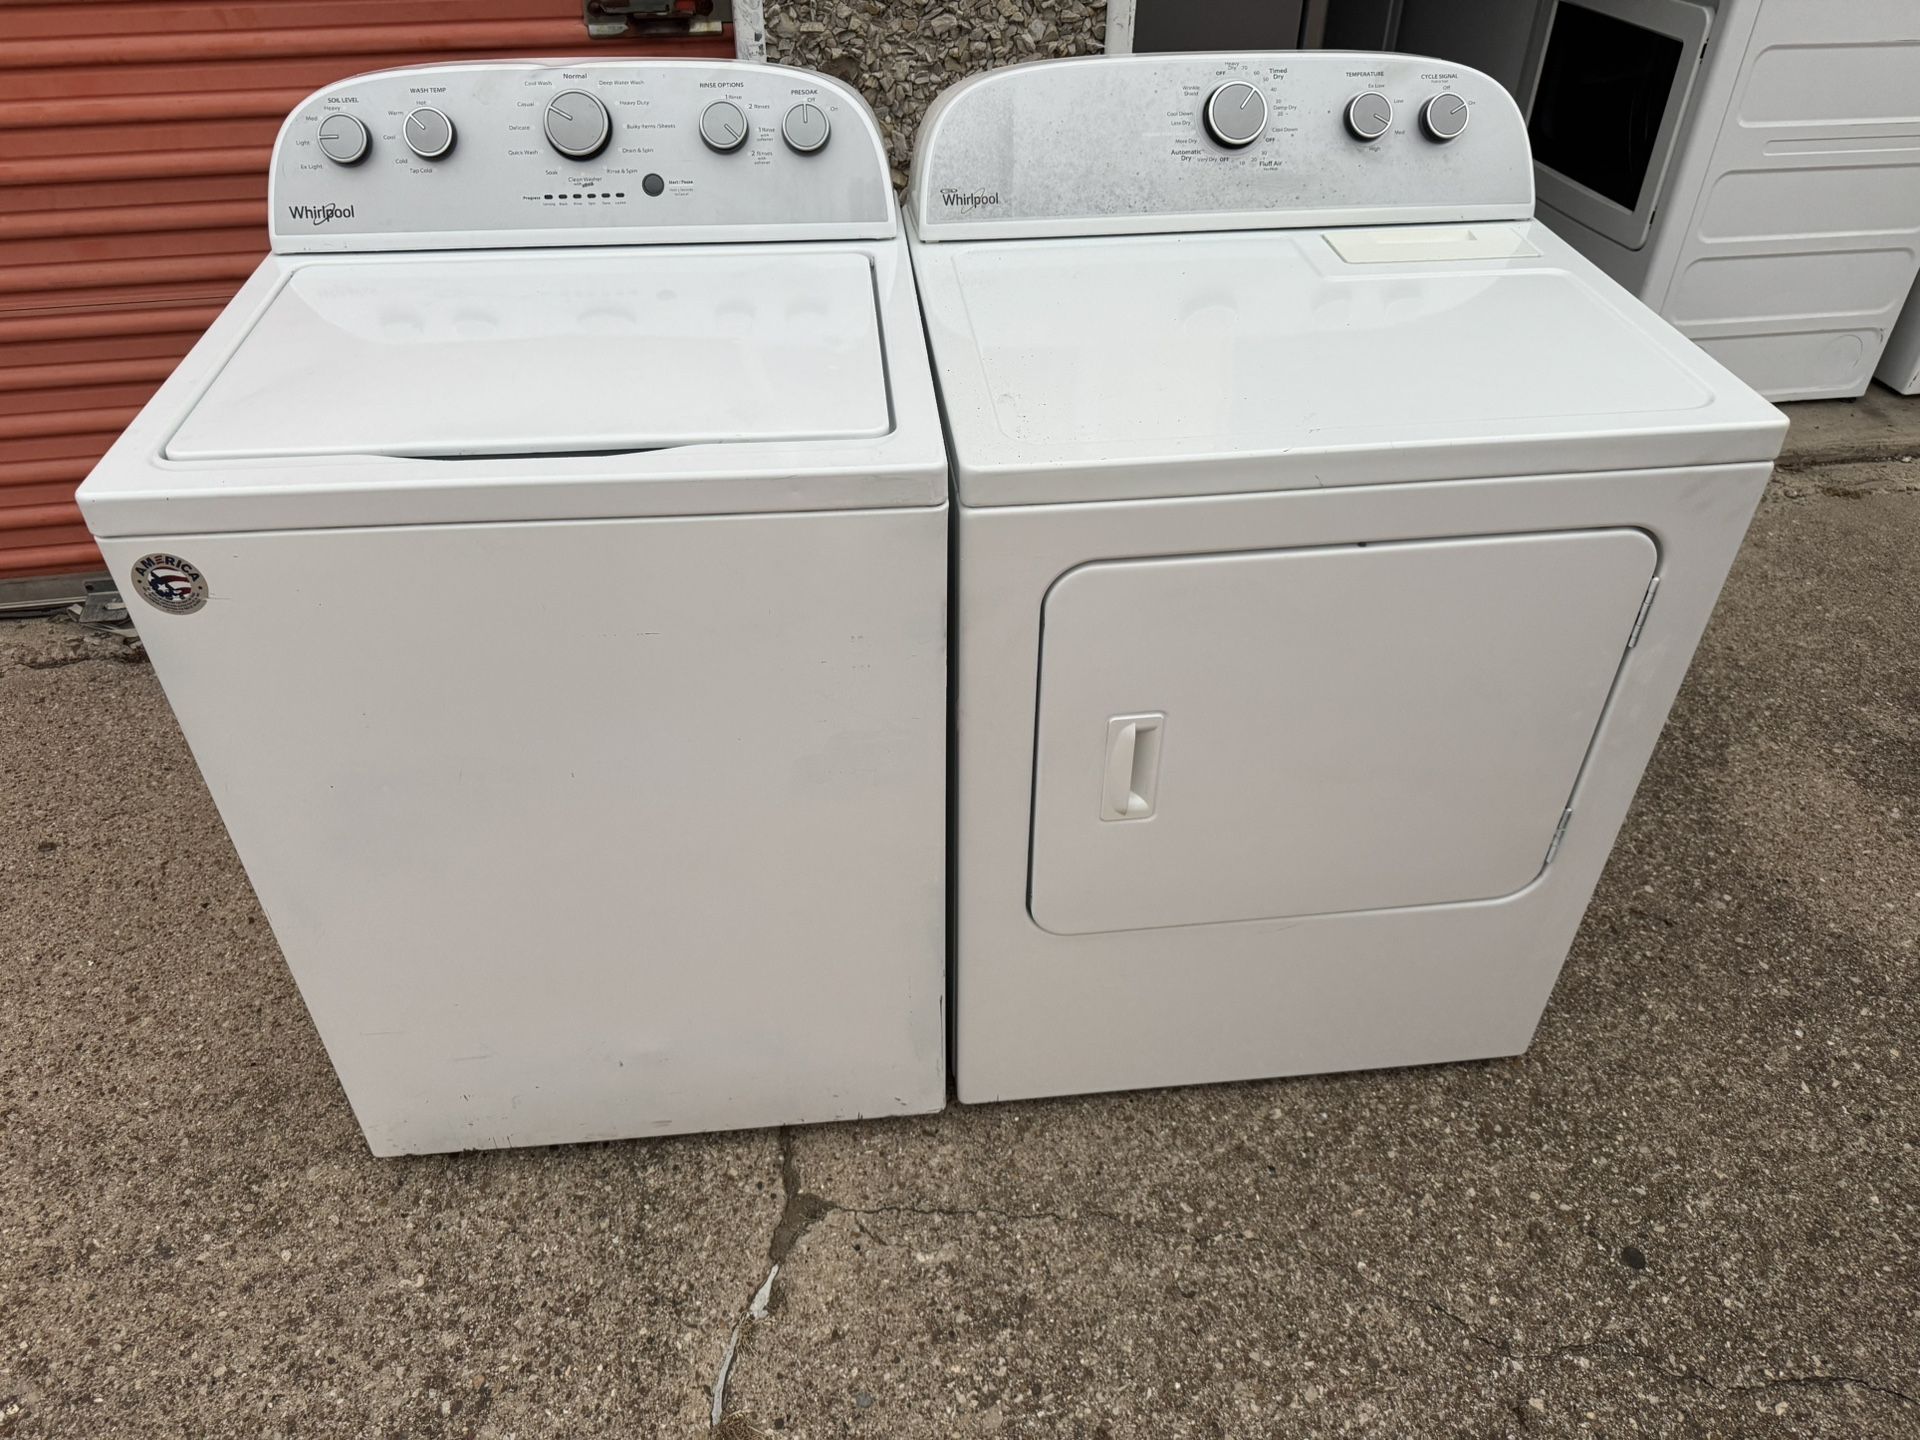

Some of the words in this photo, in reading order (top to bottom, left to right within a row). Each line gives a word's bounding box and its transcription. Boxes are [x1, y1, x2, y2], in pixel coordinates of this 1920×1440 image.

[942, 191, 999, 209] Whirlpool
[288, 203, 355, 225] Whirlpool
[135, 555, 200, 582] AMERICA
